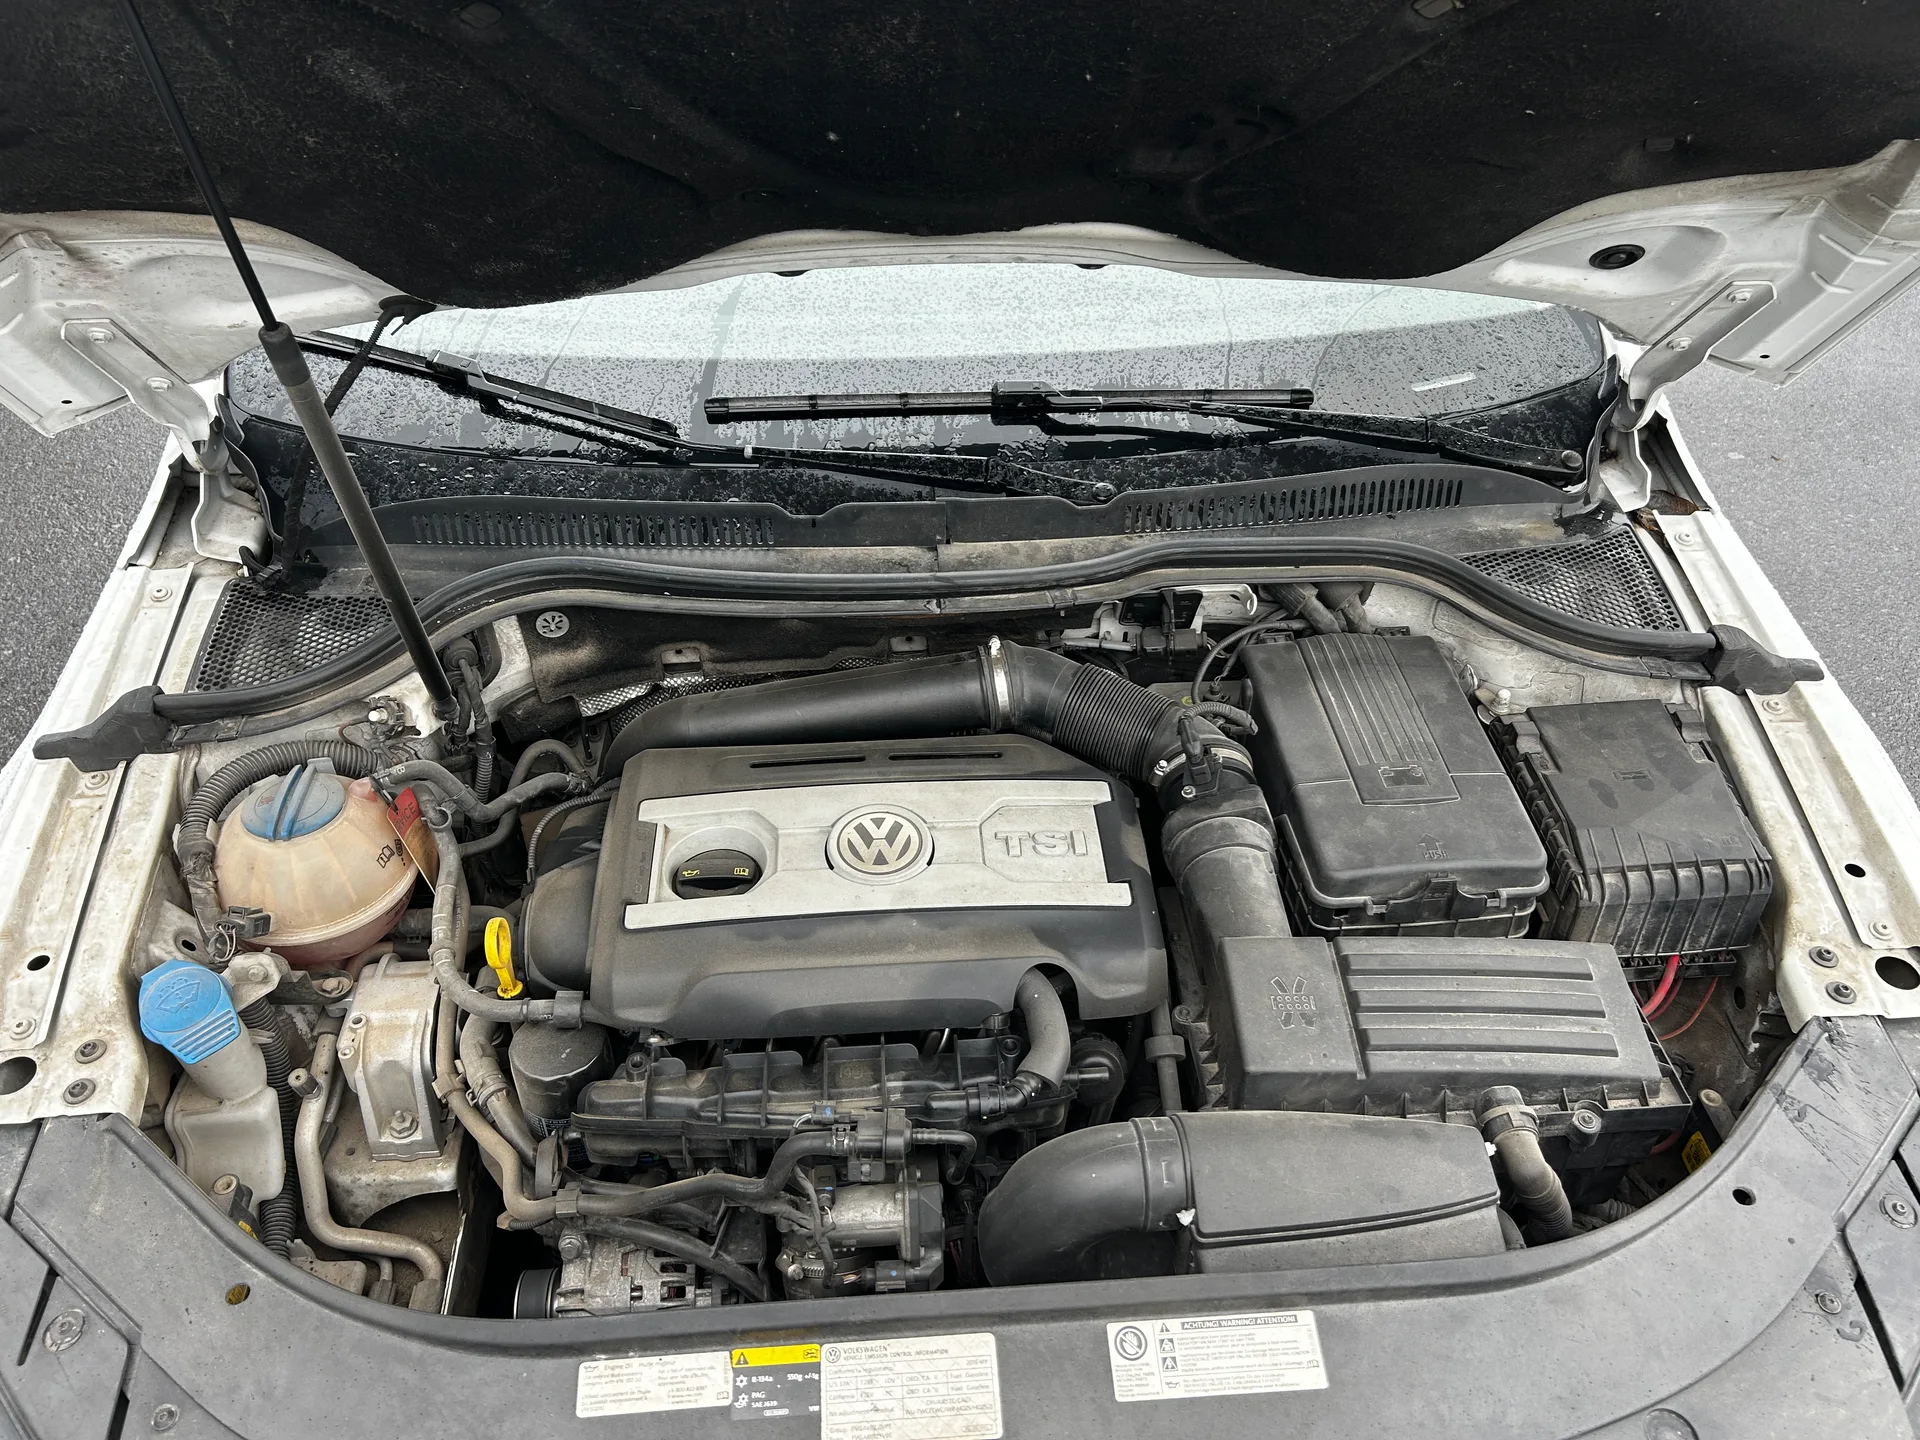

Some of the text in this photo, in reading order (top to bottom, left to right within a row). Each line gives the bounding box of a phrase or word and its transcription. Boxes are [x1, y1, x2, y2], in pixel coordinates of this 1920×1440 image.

[994, 830, 1089, 858] TSI
[1422, 850, 1450, 860] PUSH
[1183, 1316, 1296, 1329] ACHTUNG! WARNING! ATTENTION!
[843, 1345, 887, 1355] VOLKSWAGEN
[914, 1348, 949, 1357] INFORMATION
[604, 1363, 624, 1371] Engine
[751, 1375, 773, 1383] R-134a
[786, 1373, 803, 1382] 550g
[751, 1391, 766, 1399] PAG
